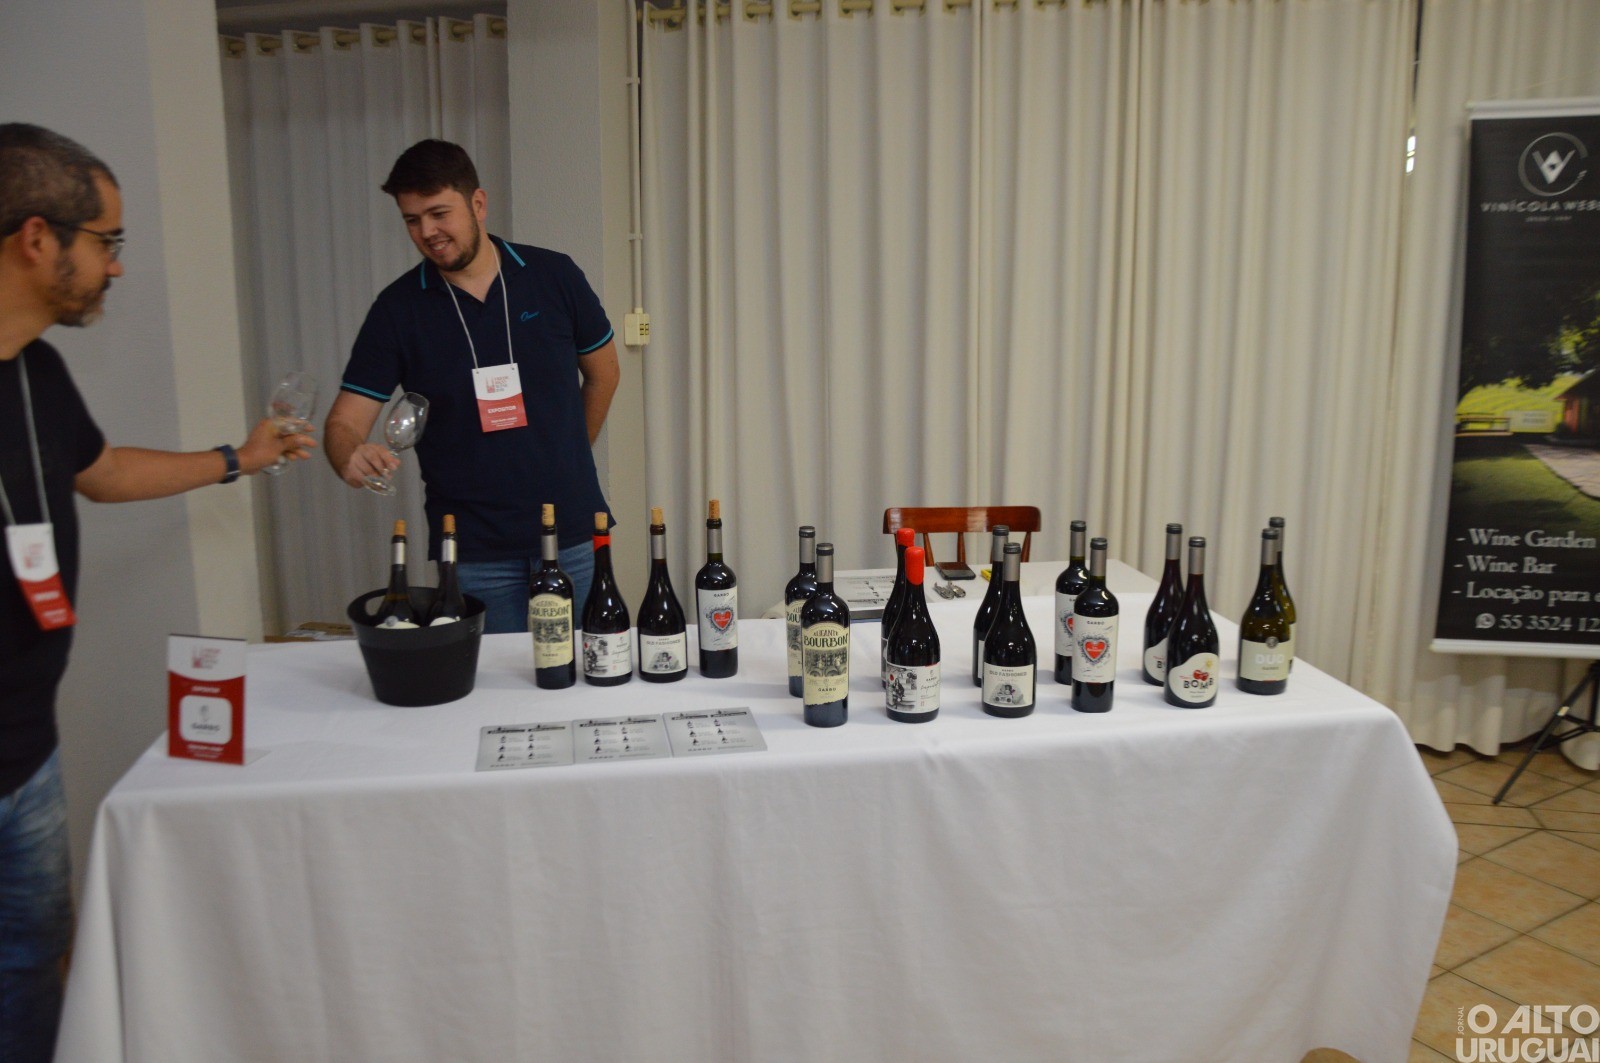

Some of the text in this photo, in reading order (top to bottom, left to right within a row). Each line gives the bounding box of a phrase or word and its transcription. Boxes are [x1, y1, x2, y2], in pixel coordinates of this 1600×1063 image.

[1468, 528, 1521, 546] Wine
[1524, 530, 1597, 549] Garden
[1466, 555, 1519, 573] Wine
[1522, 557, 1557, 574] Bar
[1466, 581, 1544, 604] Locação
[1548, 590, 1591, 607] para
[1498, 614, 1523, 629] 55
[1526, 616, 1572, 631] 3524
[804, 633, 848, 648] BOURBON
[1256, 654, 1285, 665] DUO
[1184, 678, 1214, 689] BOMB
